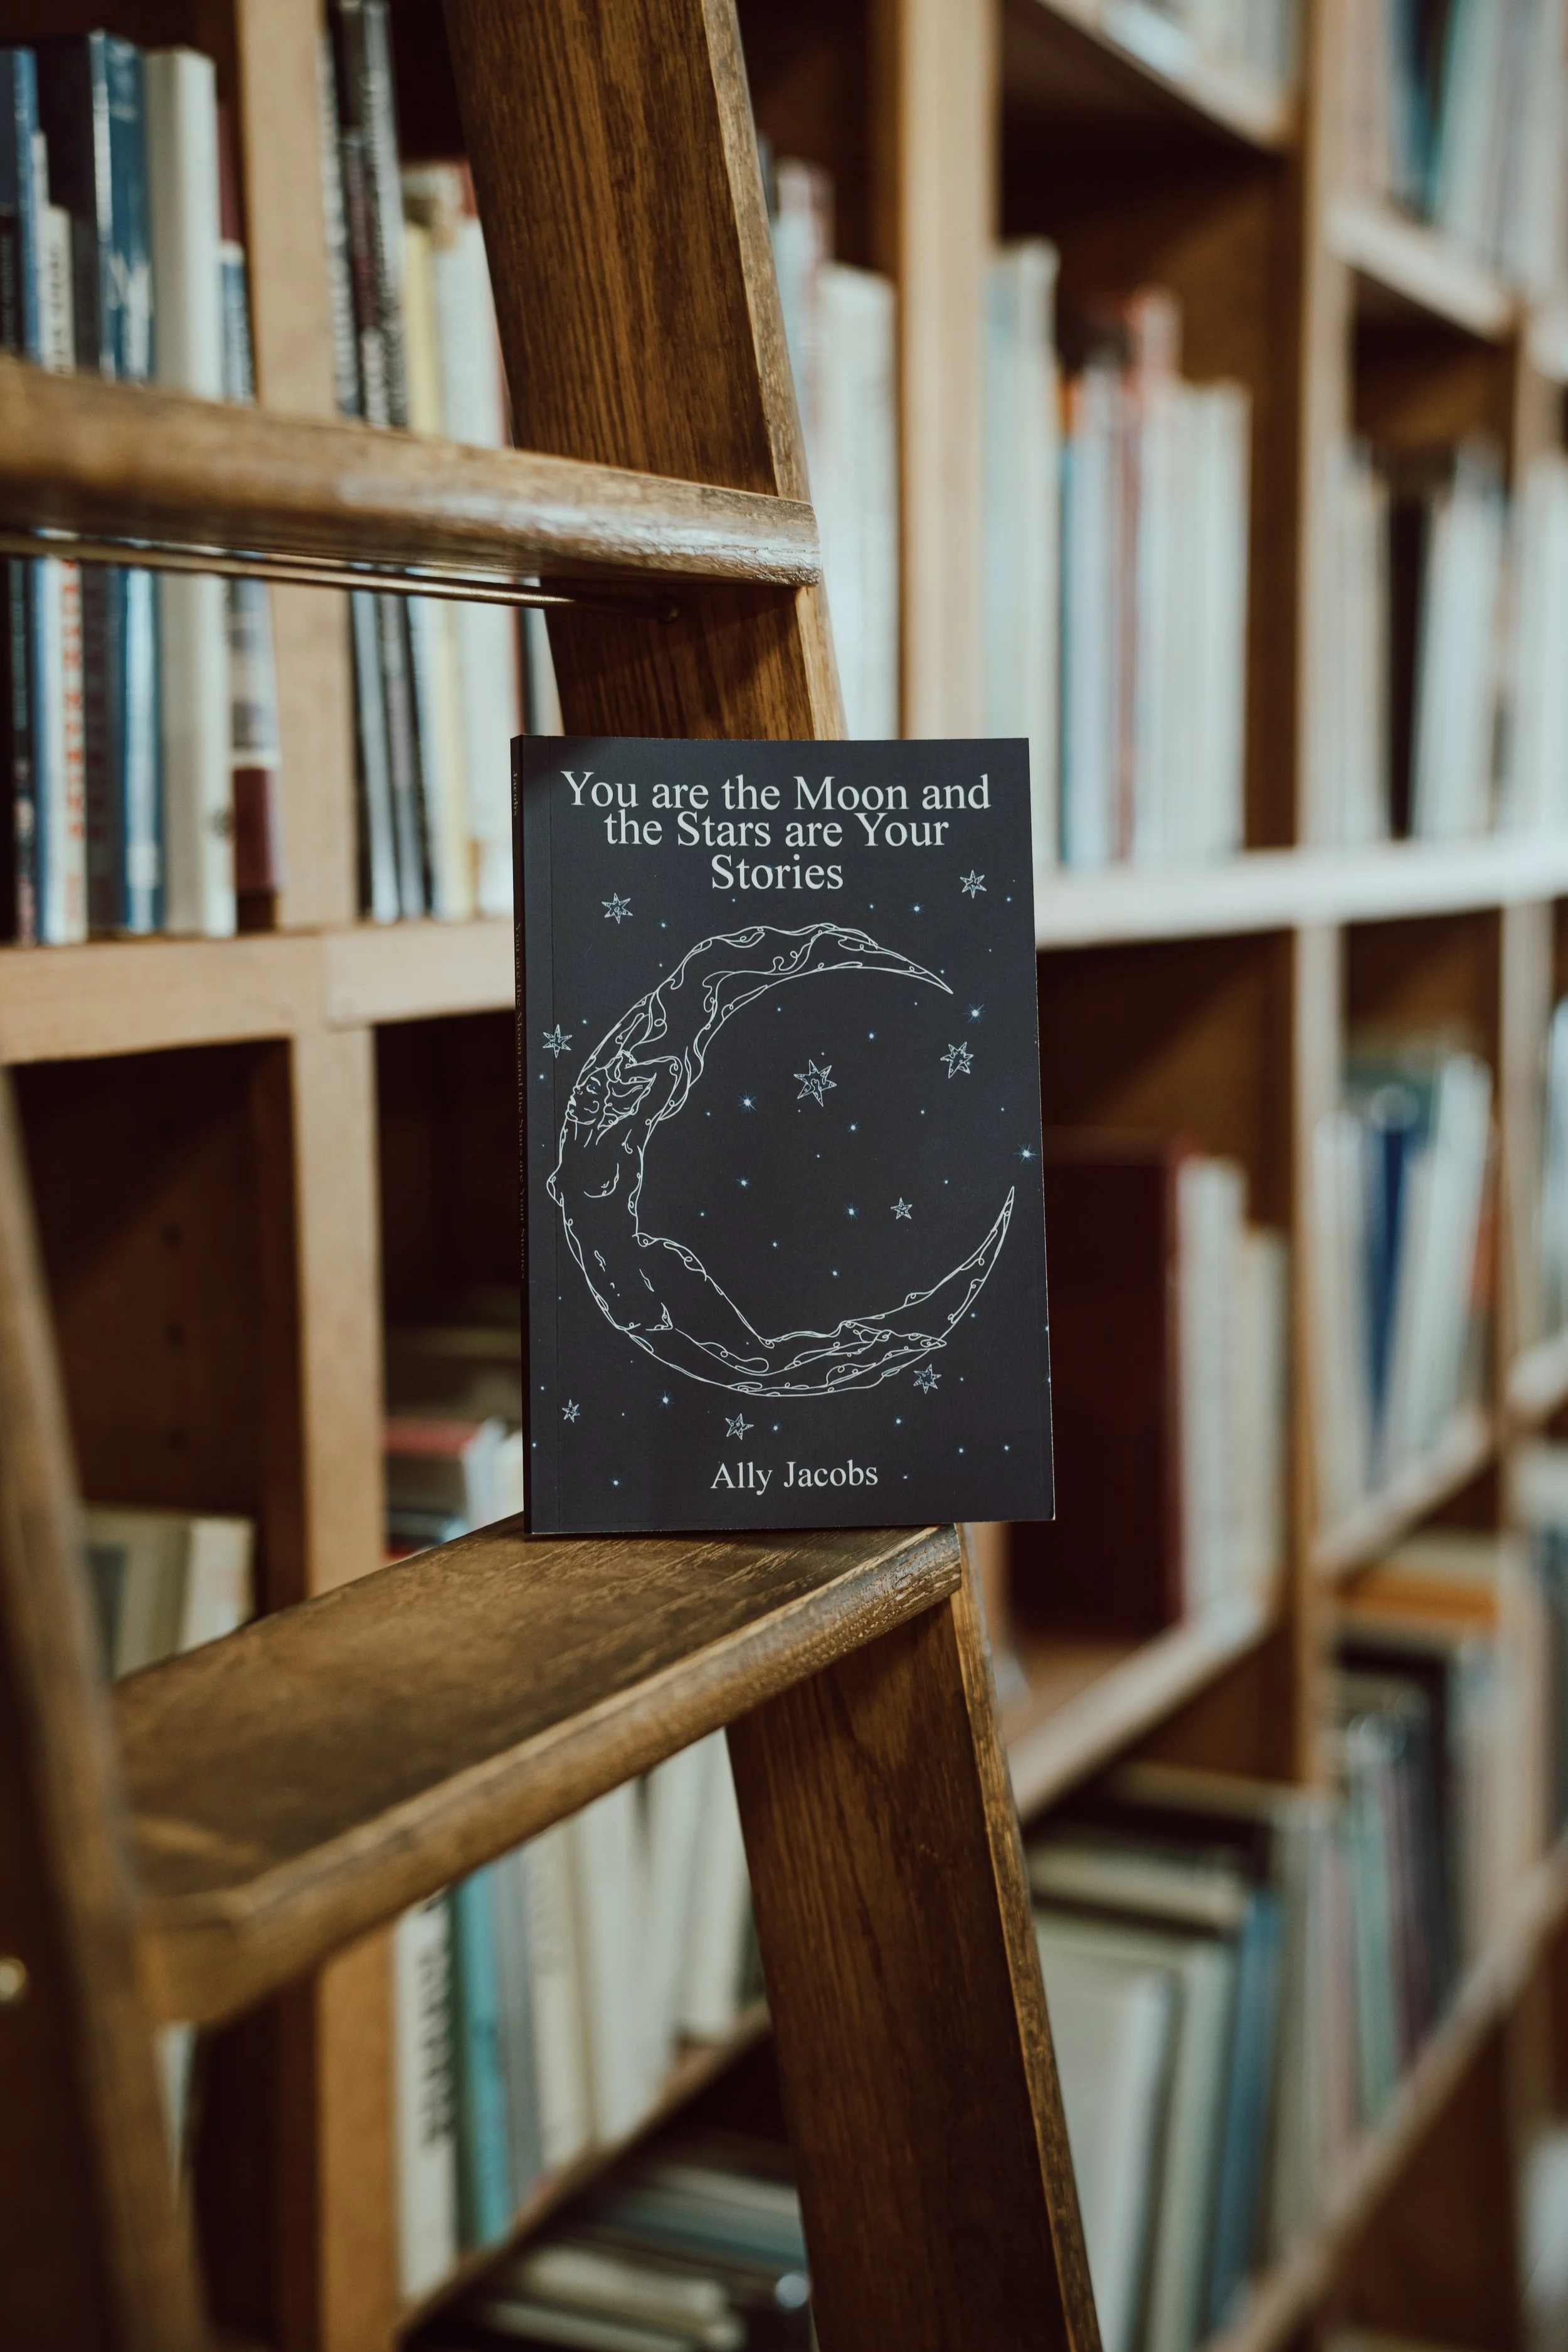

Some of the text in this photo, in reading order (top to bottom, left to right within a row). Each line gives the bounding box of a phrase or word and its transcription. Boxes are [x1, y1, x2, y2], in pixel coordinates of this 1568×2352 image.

[561, 771, 992, 810] You are the Moon and
[603, 809, 950, 847] the Stars are Your
[712, 854, 844, 890] Stories
[710, 1459, 878, 1496] Ally Jacobs
